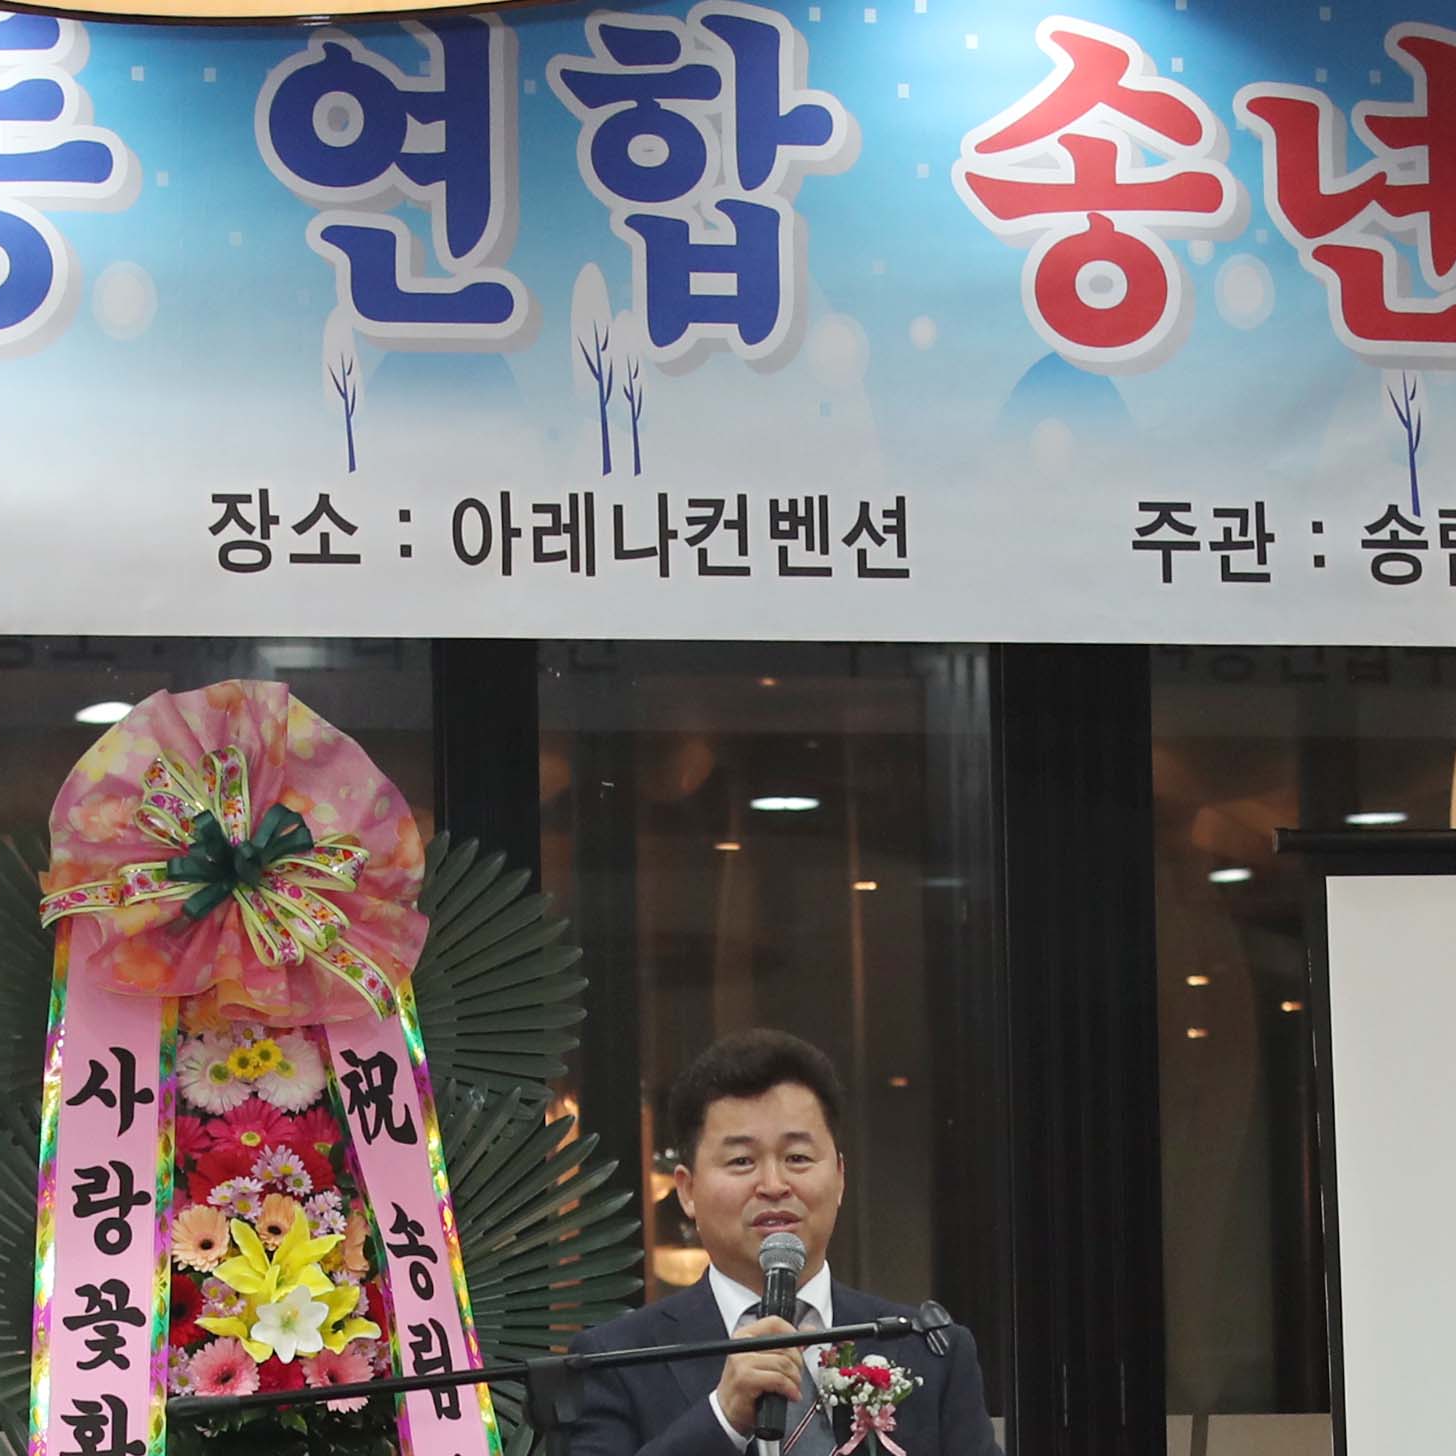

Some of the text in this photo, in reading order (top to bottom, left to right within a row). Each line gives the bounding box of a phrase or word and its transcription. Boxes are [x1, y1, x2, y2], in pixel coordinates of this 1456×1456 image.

[268, 14, 835, 348] 연합
[207, 489, 361, 574] 장소
[452, 490, 910, 579] 아레나컨벤션
[1131, 500, 1276, 584] 주관
[340, 1048, 418, 1146] 祝
